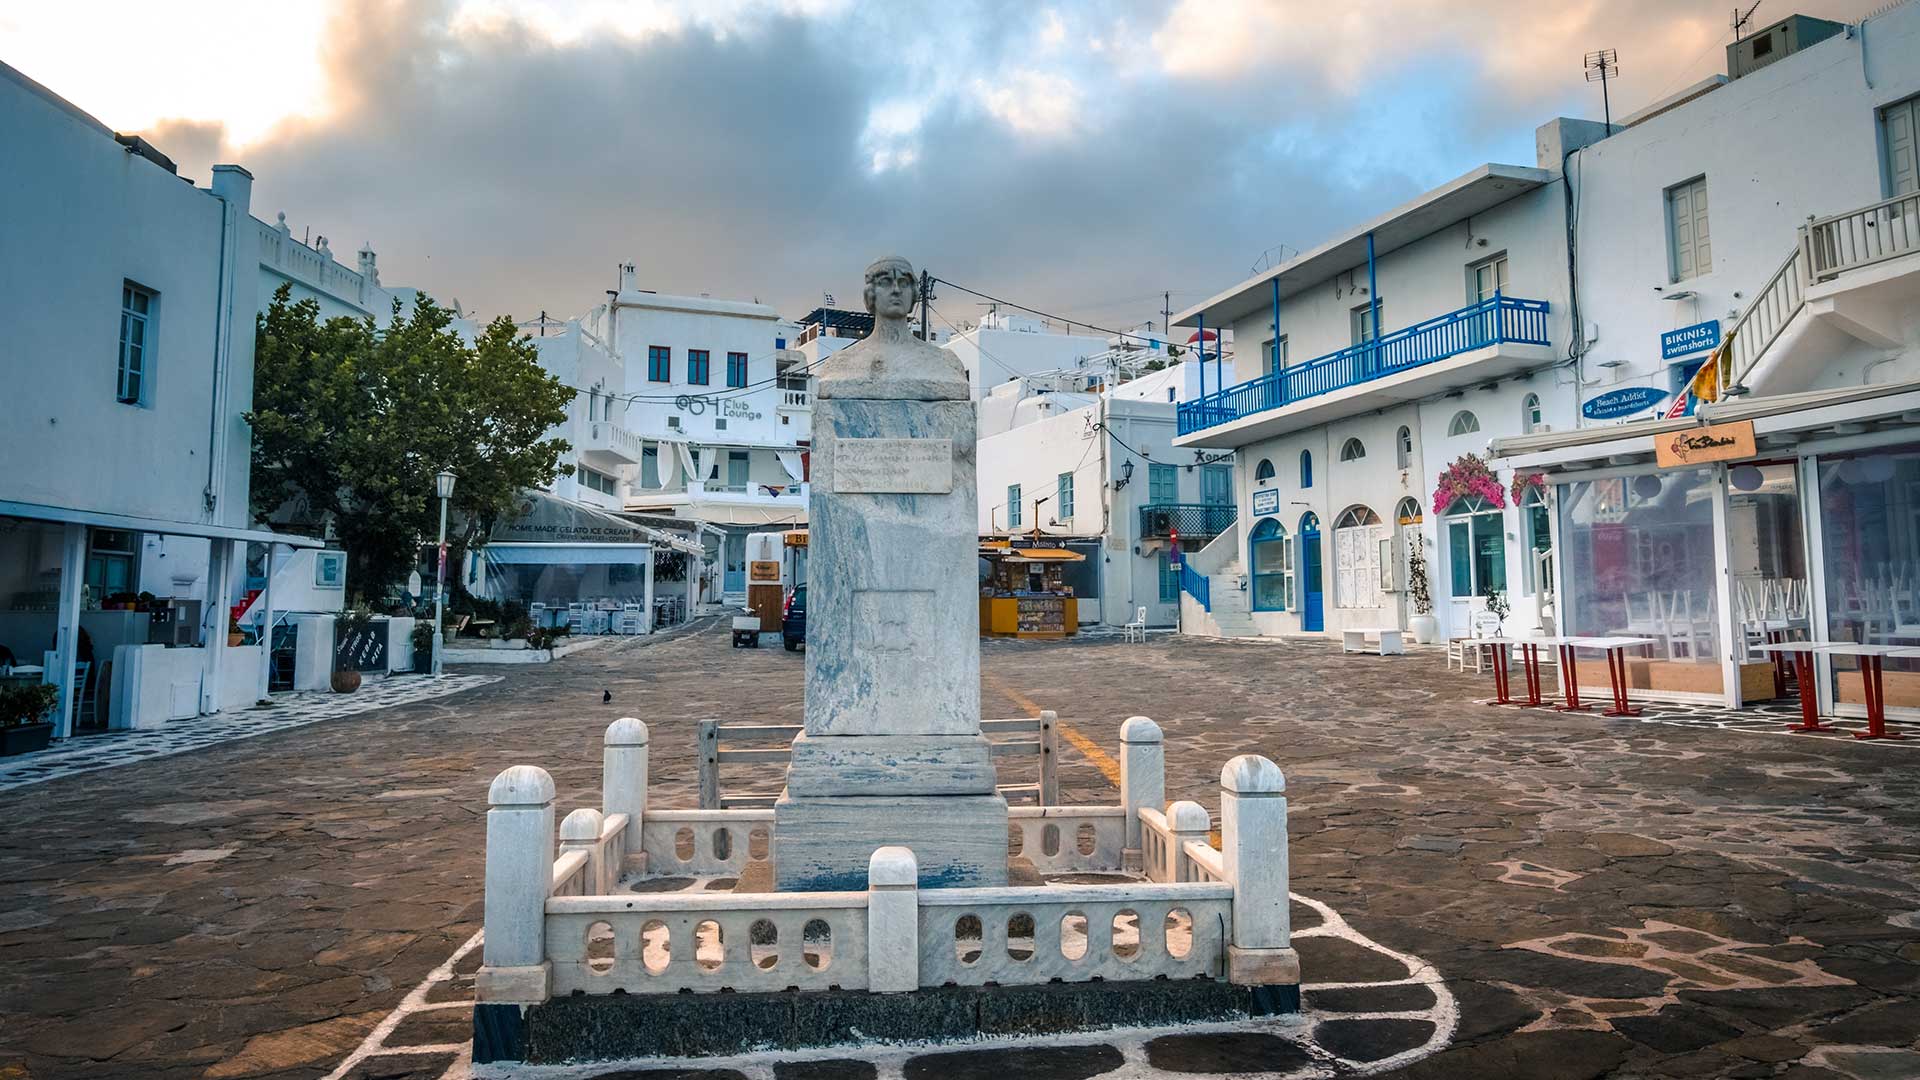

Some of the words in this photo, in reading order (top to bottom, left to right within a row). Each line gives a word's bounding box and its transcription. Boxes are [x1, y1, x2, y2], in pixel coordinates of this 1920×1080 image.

[1665, 327, 1706, 345] BIKINIS
[723, 399, 750, 411] Club
[1596, 396, 1619, 407] Beach
[1621, 391, 1647, 402] Addict
[723, 407, 762, 421] Lounge
[508, 524, 532, 533] HOME
[534, 525, 557, 533] MADE
[559, 526, 589, 535] GELATO
[590, 527, 602, 535] ICE
[603, 528, 631, 536] CREAM
